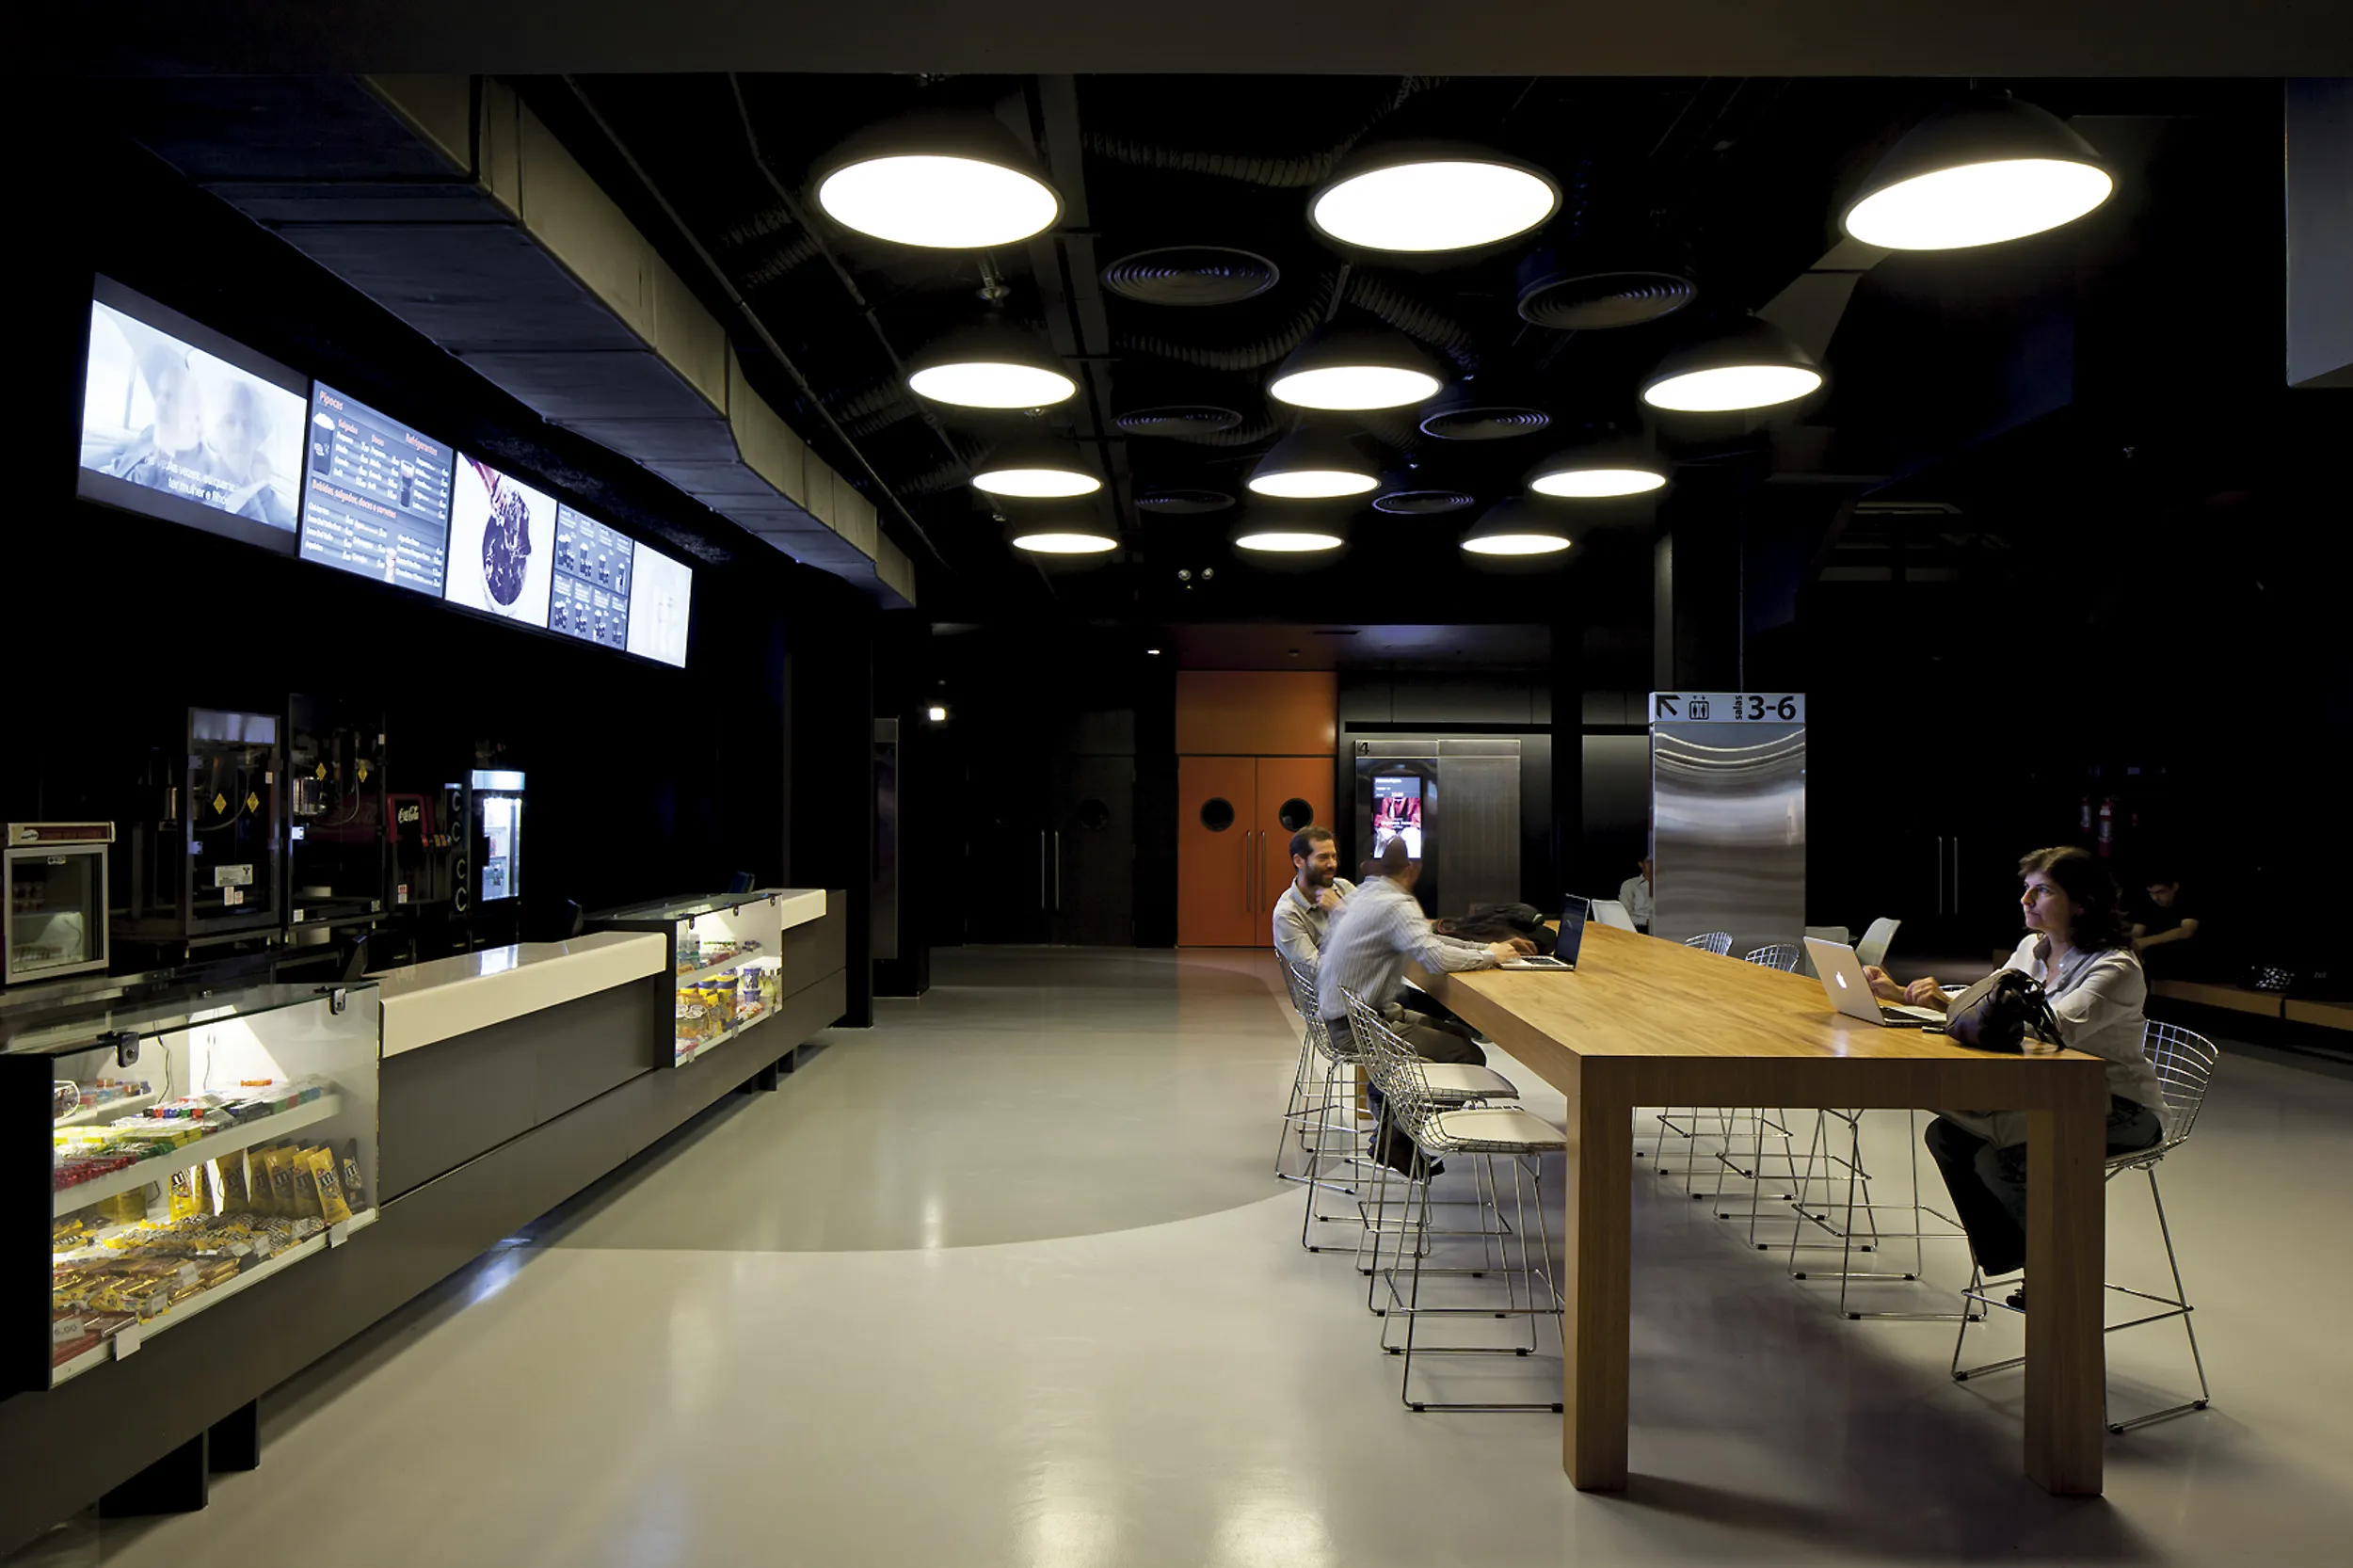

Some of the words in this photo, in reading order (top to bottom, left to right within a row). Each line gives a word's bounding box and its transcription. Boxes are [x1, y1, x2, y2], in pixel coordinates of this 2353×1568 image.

[319, 390, 344, 411] Pipocas
[1733, 695, 1743, 720] salas
[1748, 695, 1797, 721] 3-6
[1358, 742, 1369, 755] 4
